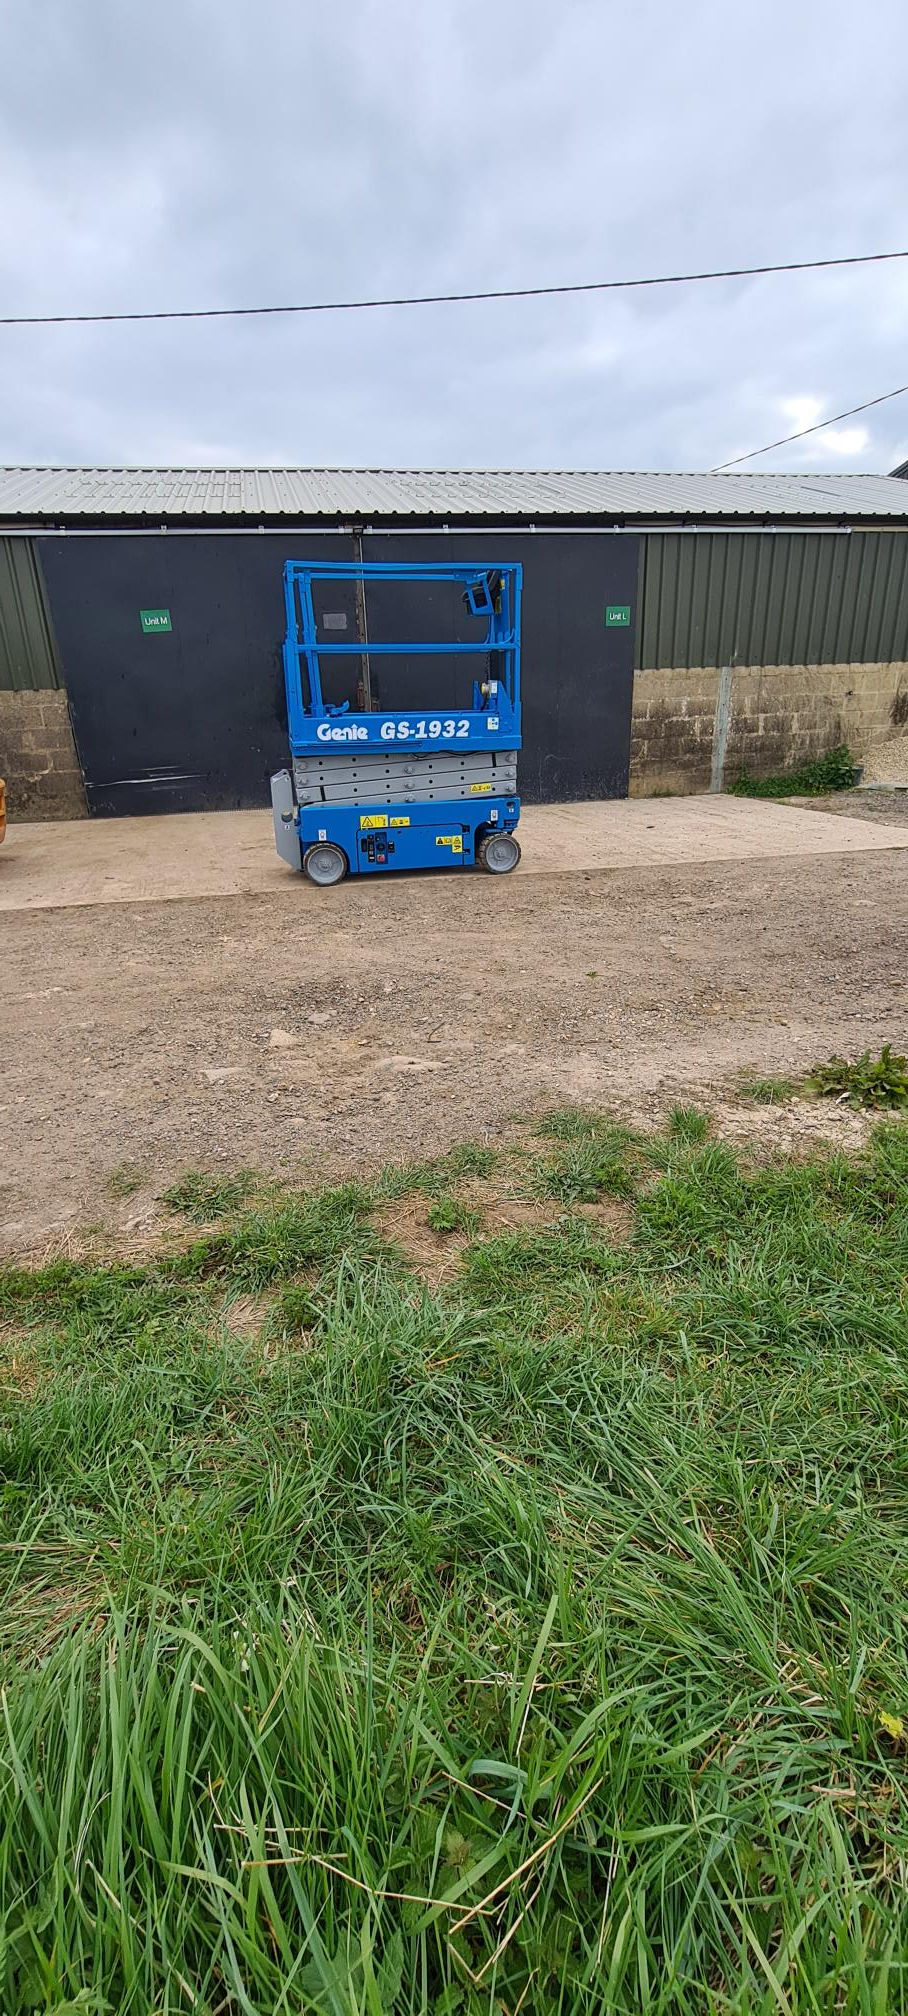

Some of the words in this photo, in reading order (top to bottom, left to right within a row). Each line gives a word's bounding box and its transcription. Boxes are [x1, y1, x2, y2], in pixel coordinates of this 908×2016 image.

[145, 617, 160, 626] Unit
[160, 616, 168, 625] M
[610, 612, 621, 620] Unit
[622, 612, 627, 620] L
[317, 723, 368, 741] Genie
[380, 719, 470, 739] GS-1932
